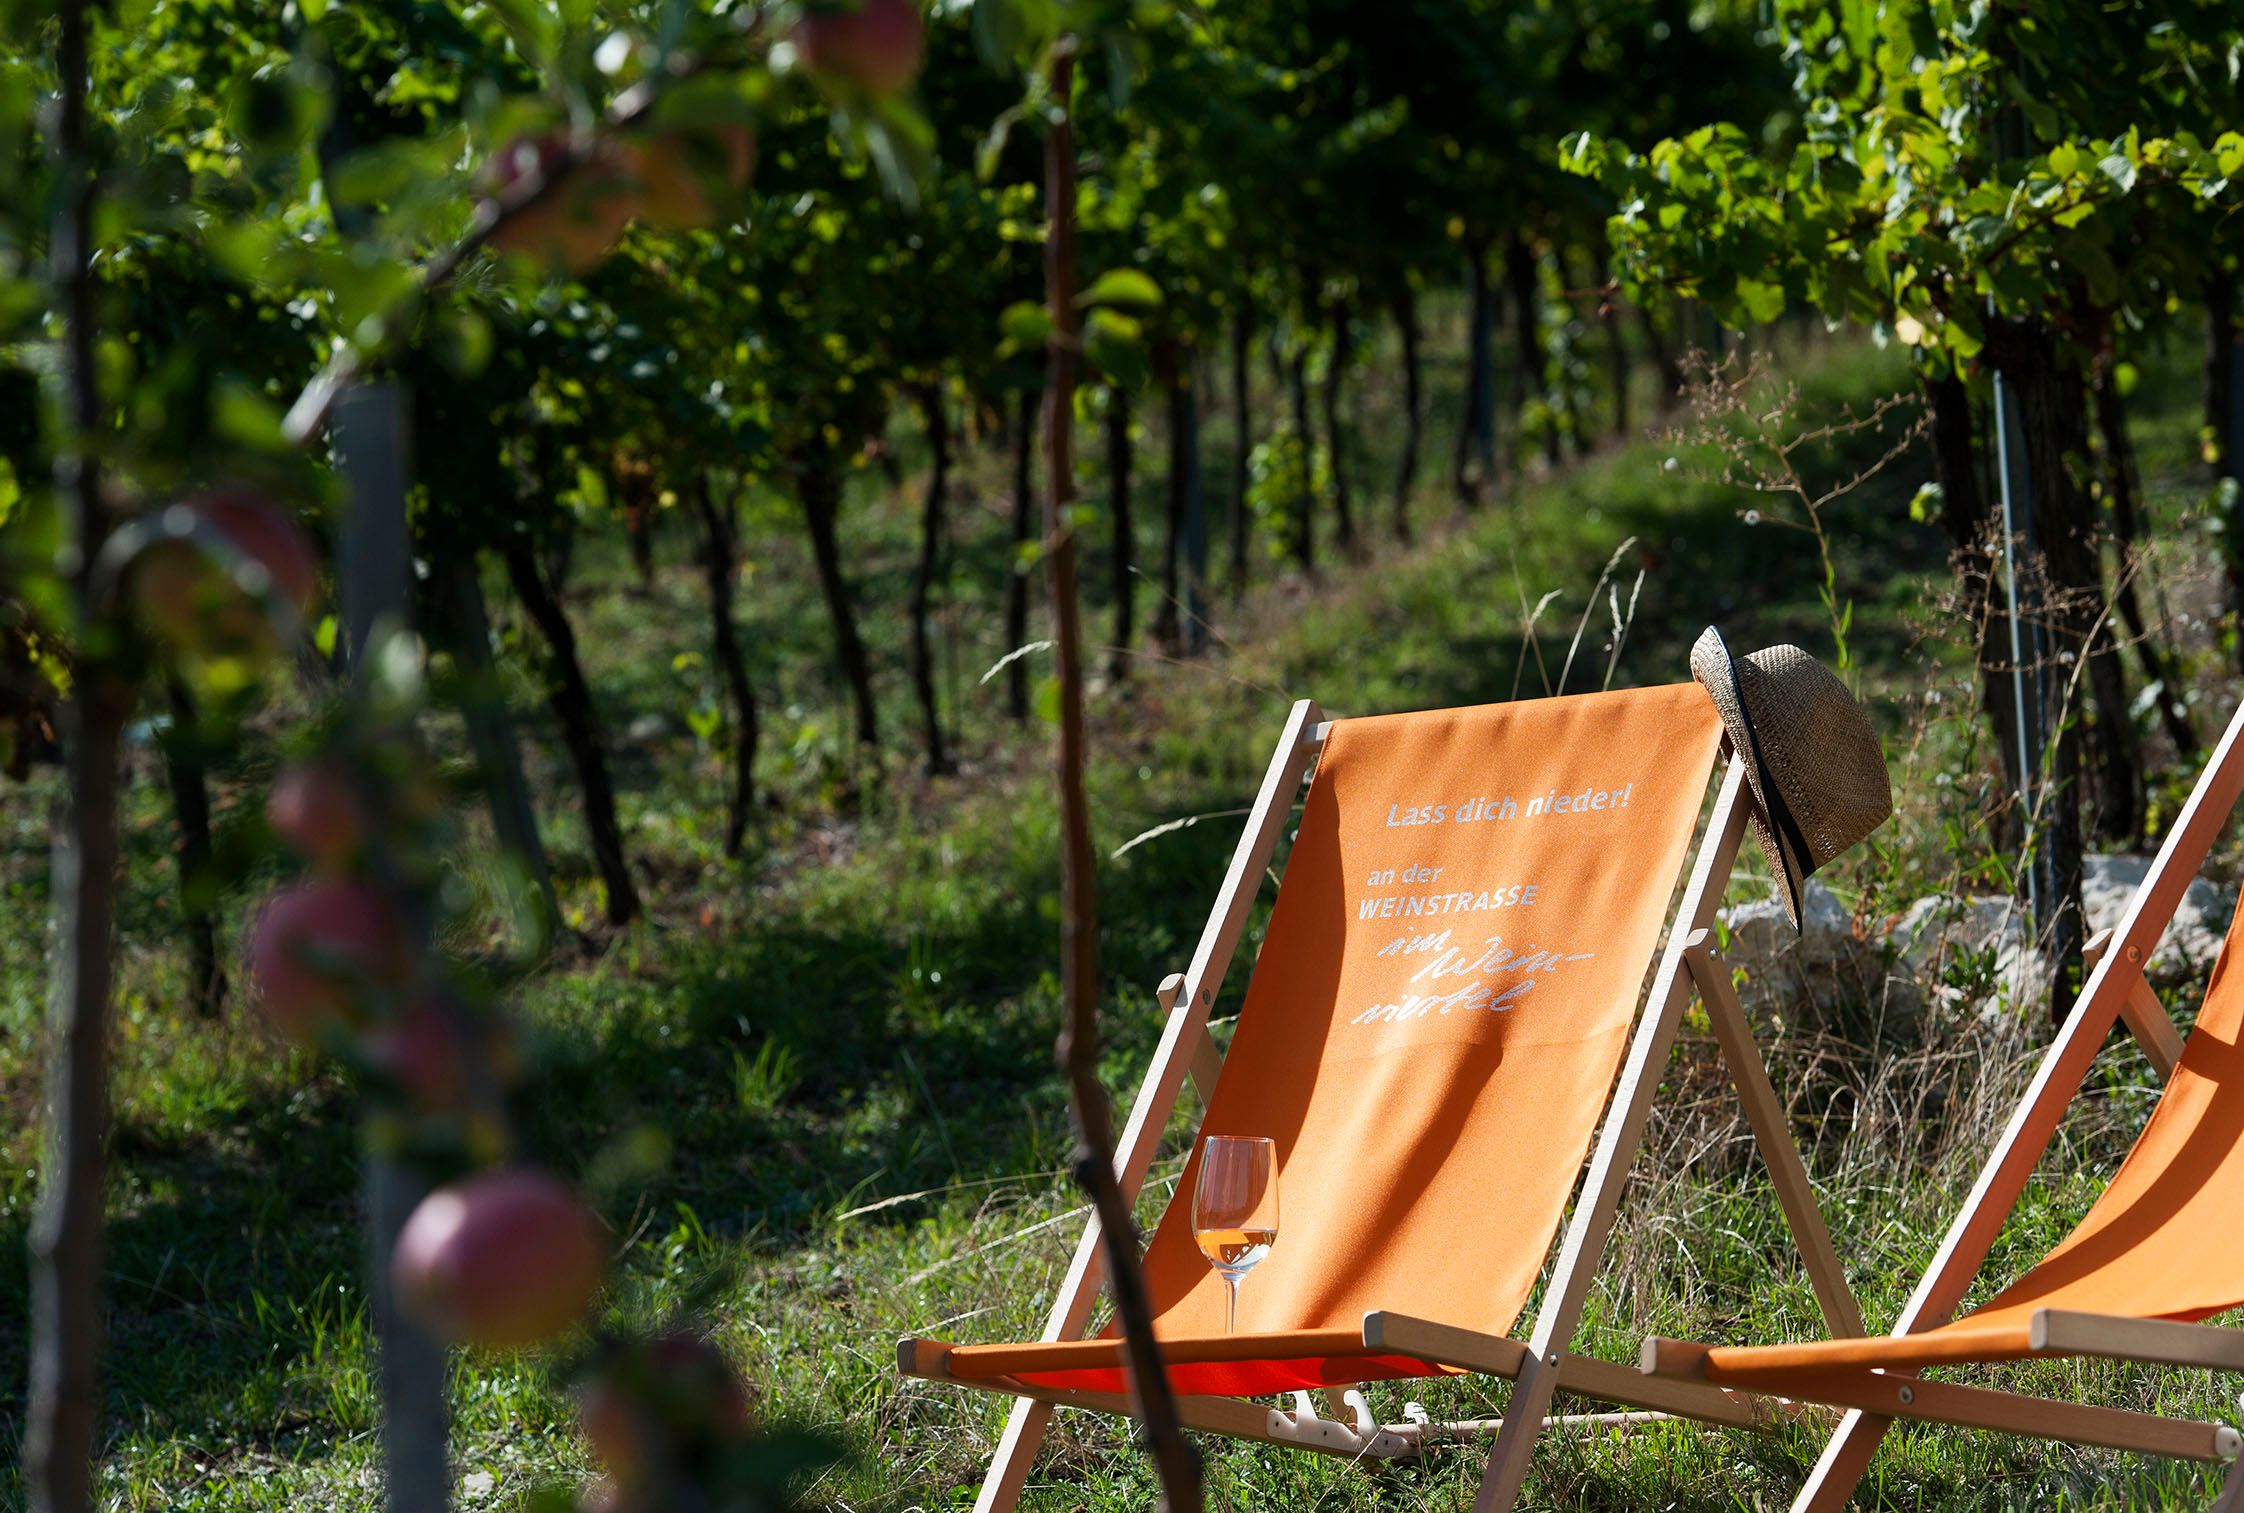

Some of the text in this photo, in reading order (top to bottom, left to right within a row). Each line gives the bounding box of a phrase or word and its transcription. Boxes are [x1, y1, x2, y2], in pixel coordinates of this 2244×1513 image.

[1385, 783, 1633, 828] Lass dich nieder!
[1366, 863, 1445, 887] an der
[1358, 884, 1541, 921] WEINSTRASSE
[1376, 926, 1453, 957] im
[1350, 979, 1536, 1025] viertel
